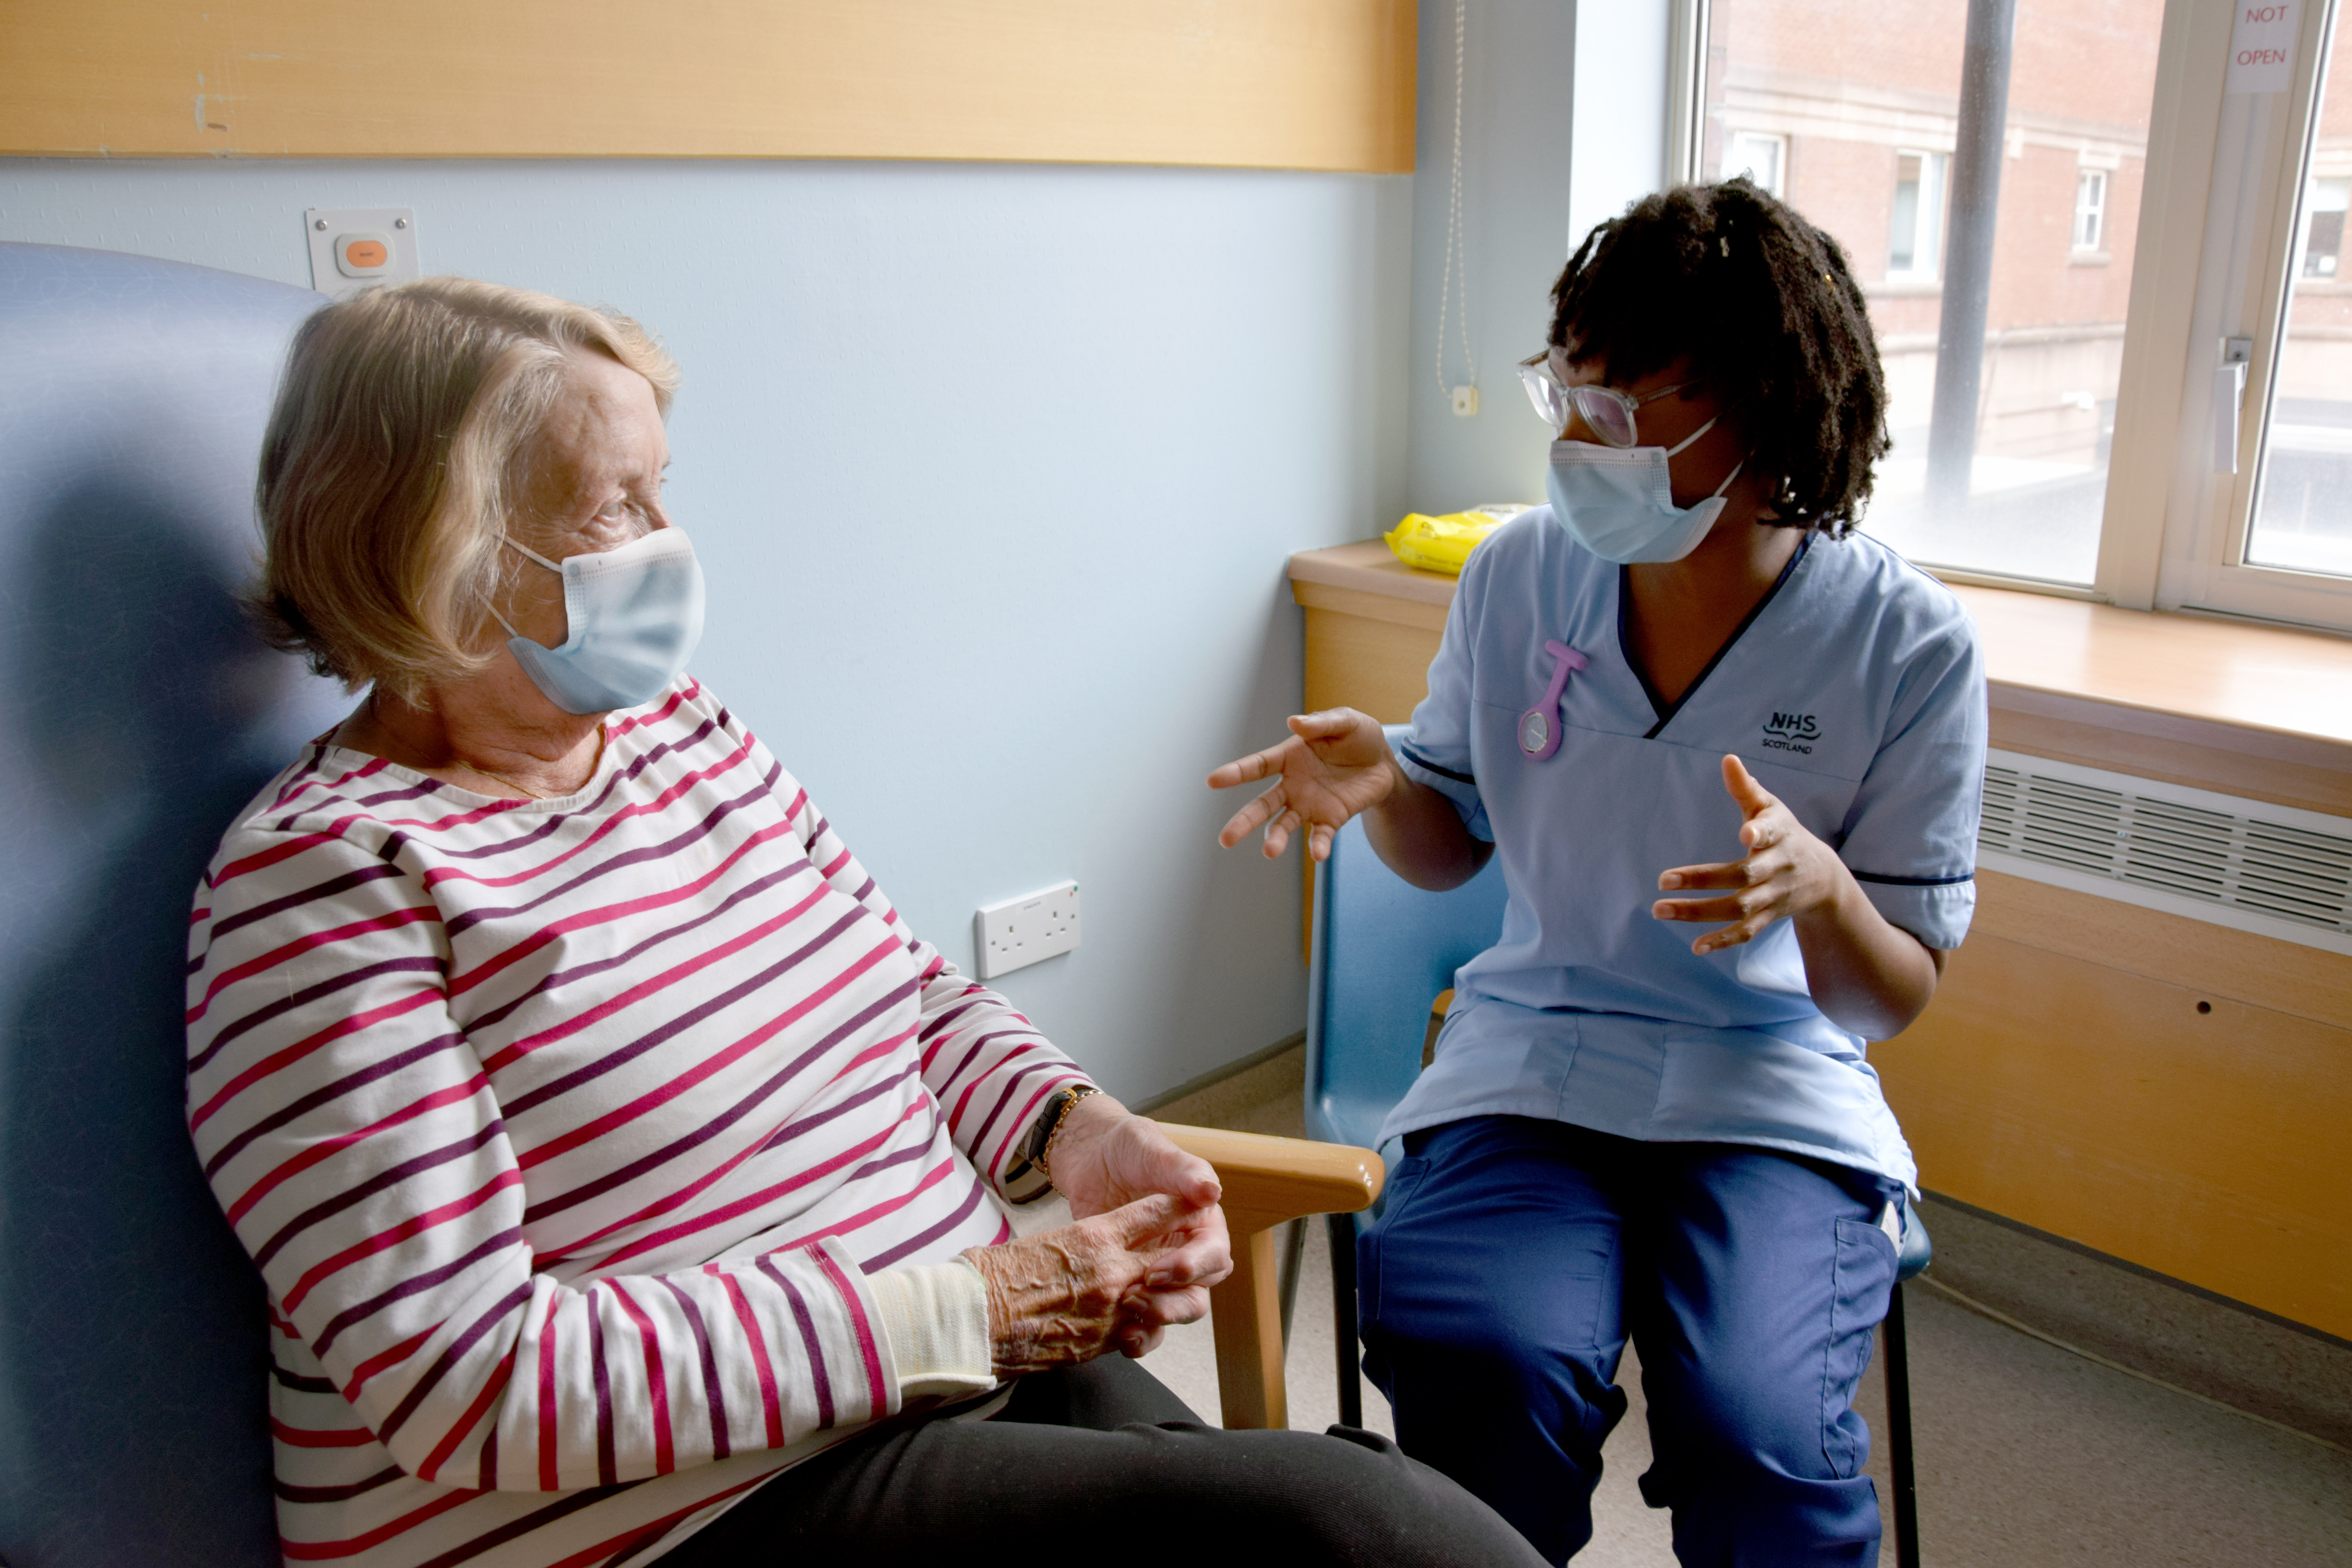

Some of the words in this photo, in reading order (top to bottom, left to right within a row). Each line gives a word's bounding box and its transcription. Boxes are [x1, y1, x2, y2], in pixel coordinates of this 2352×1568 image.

[2246, 5, 2289, 24] NOT
[2237, 48, 2286, 66] OPEN
[1770, 712, 1816, 732] NHS
[1762, 738, 1812, 754] SCOTLAND
